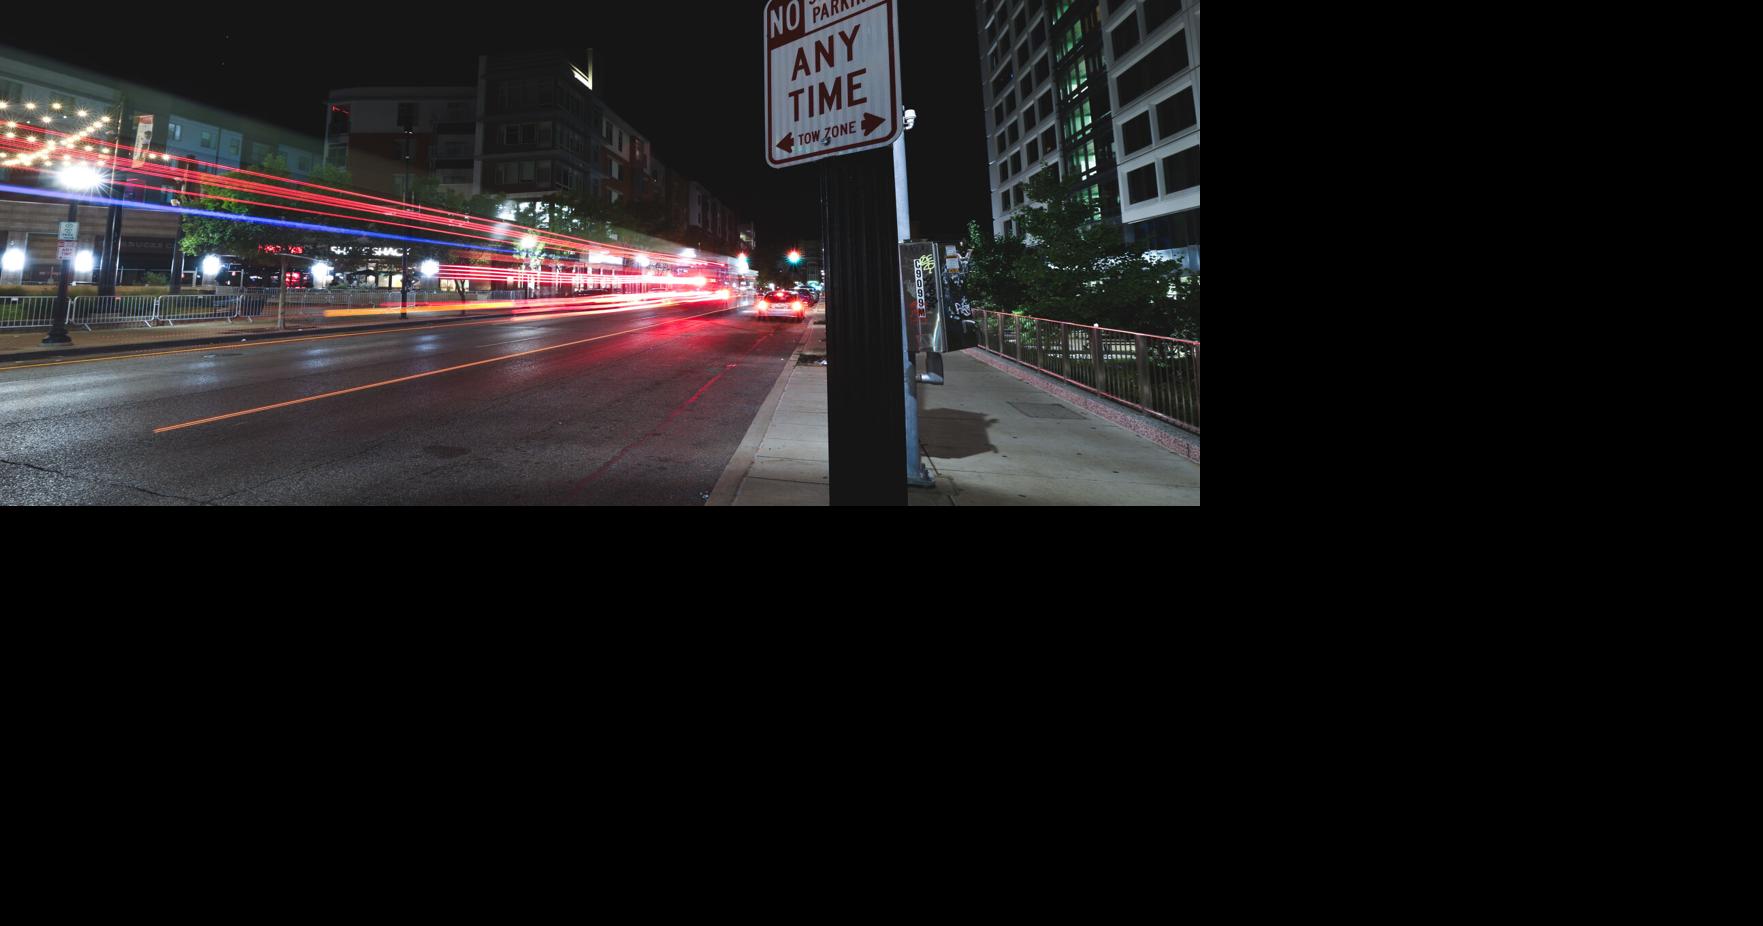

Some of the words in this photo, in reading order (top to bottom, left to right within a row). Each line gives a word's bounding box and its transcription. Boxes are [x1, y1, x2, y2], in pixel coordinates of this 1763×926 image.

[770, 0, 801, 38] NO
[791, 24, 860, 81] ANY
[788, 68, 867, 122] TIME
[798, 130, 820, 146] TOW
[824, 121, 856, 139] ZONE
